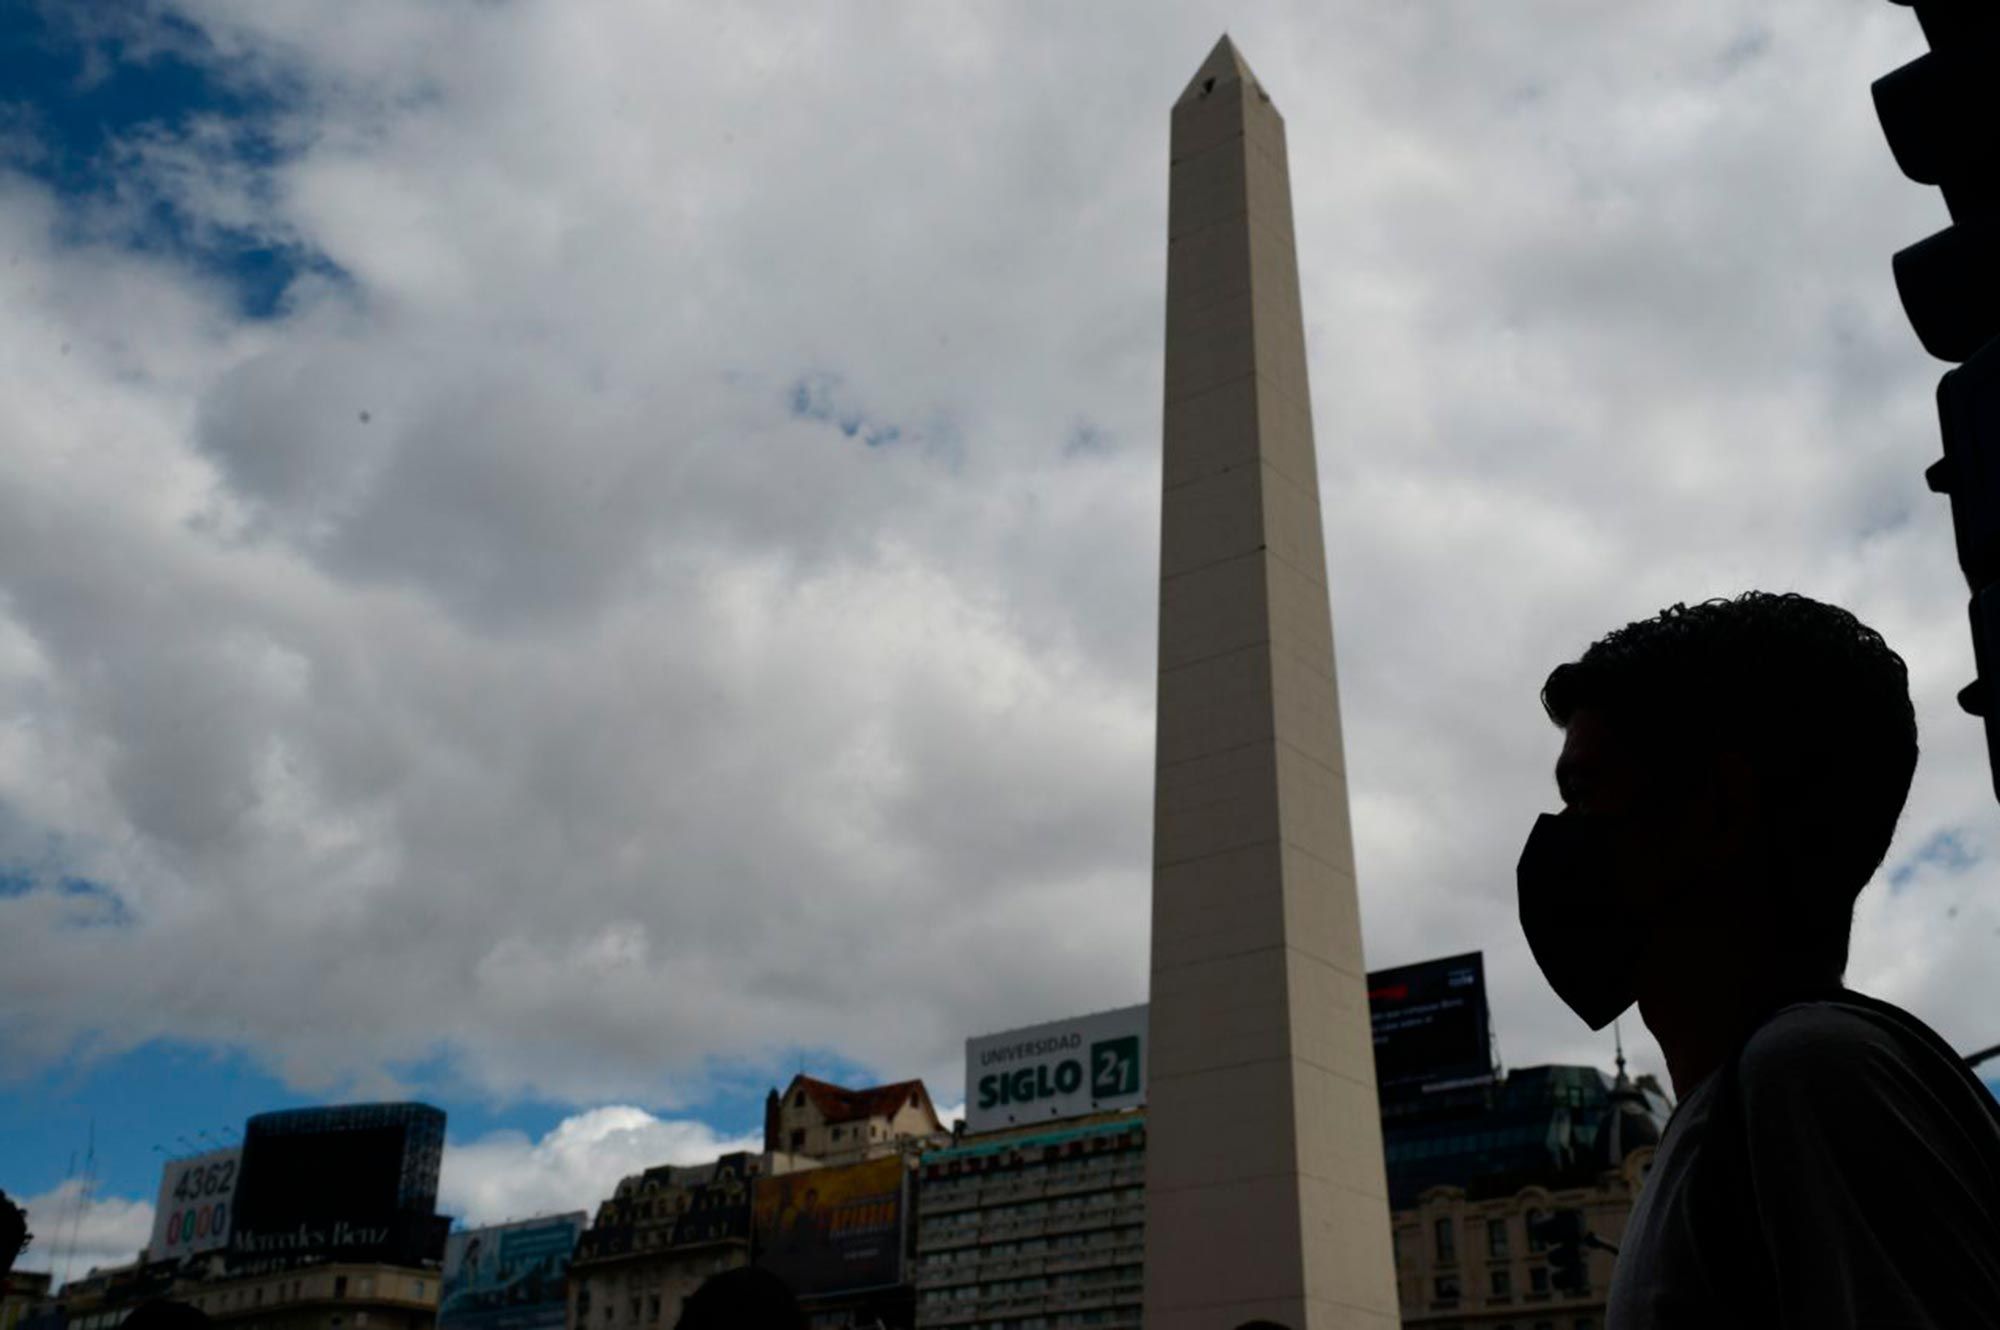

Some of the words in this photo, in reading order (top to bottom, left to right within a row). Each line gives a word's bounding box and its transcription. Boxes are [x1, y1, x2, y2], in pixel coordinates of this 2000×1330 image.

[981, 1034, 1081, 1065] UNIVERSIDAD
[978, 1059, 1082, 1110] SIGLO
[1095, 1049, 1130, 1092] 21
[175, 1160, 234, 1200] 4362
[168, 1201, 225, 1246] 0000
